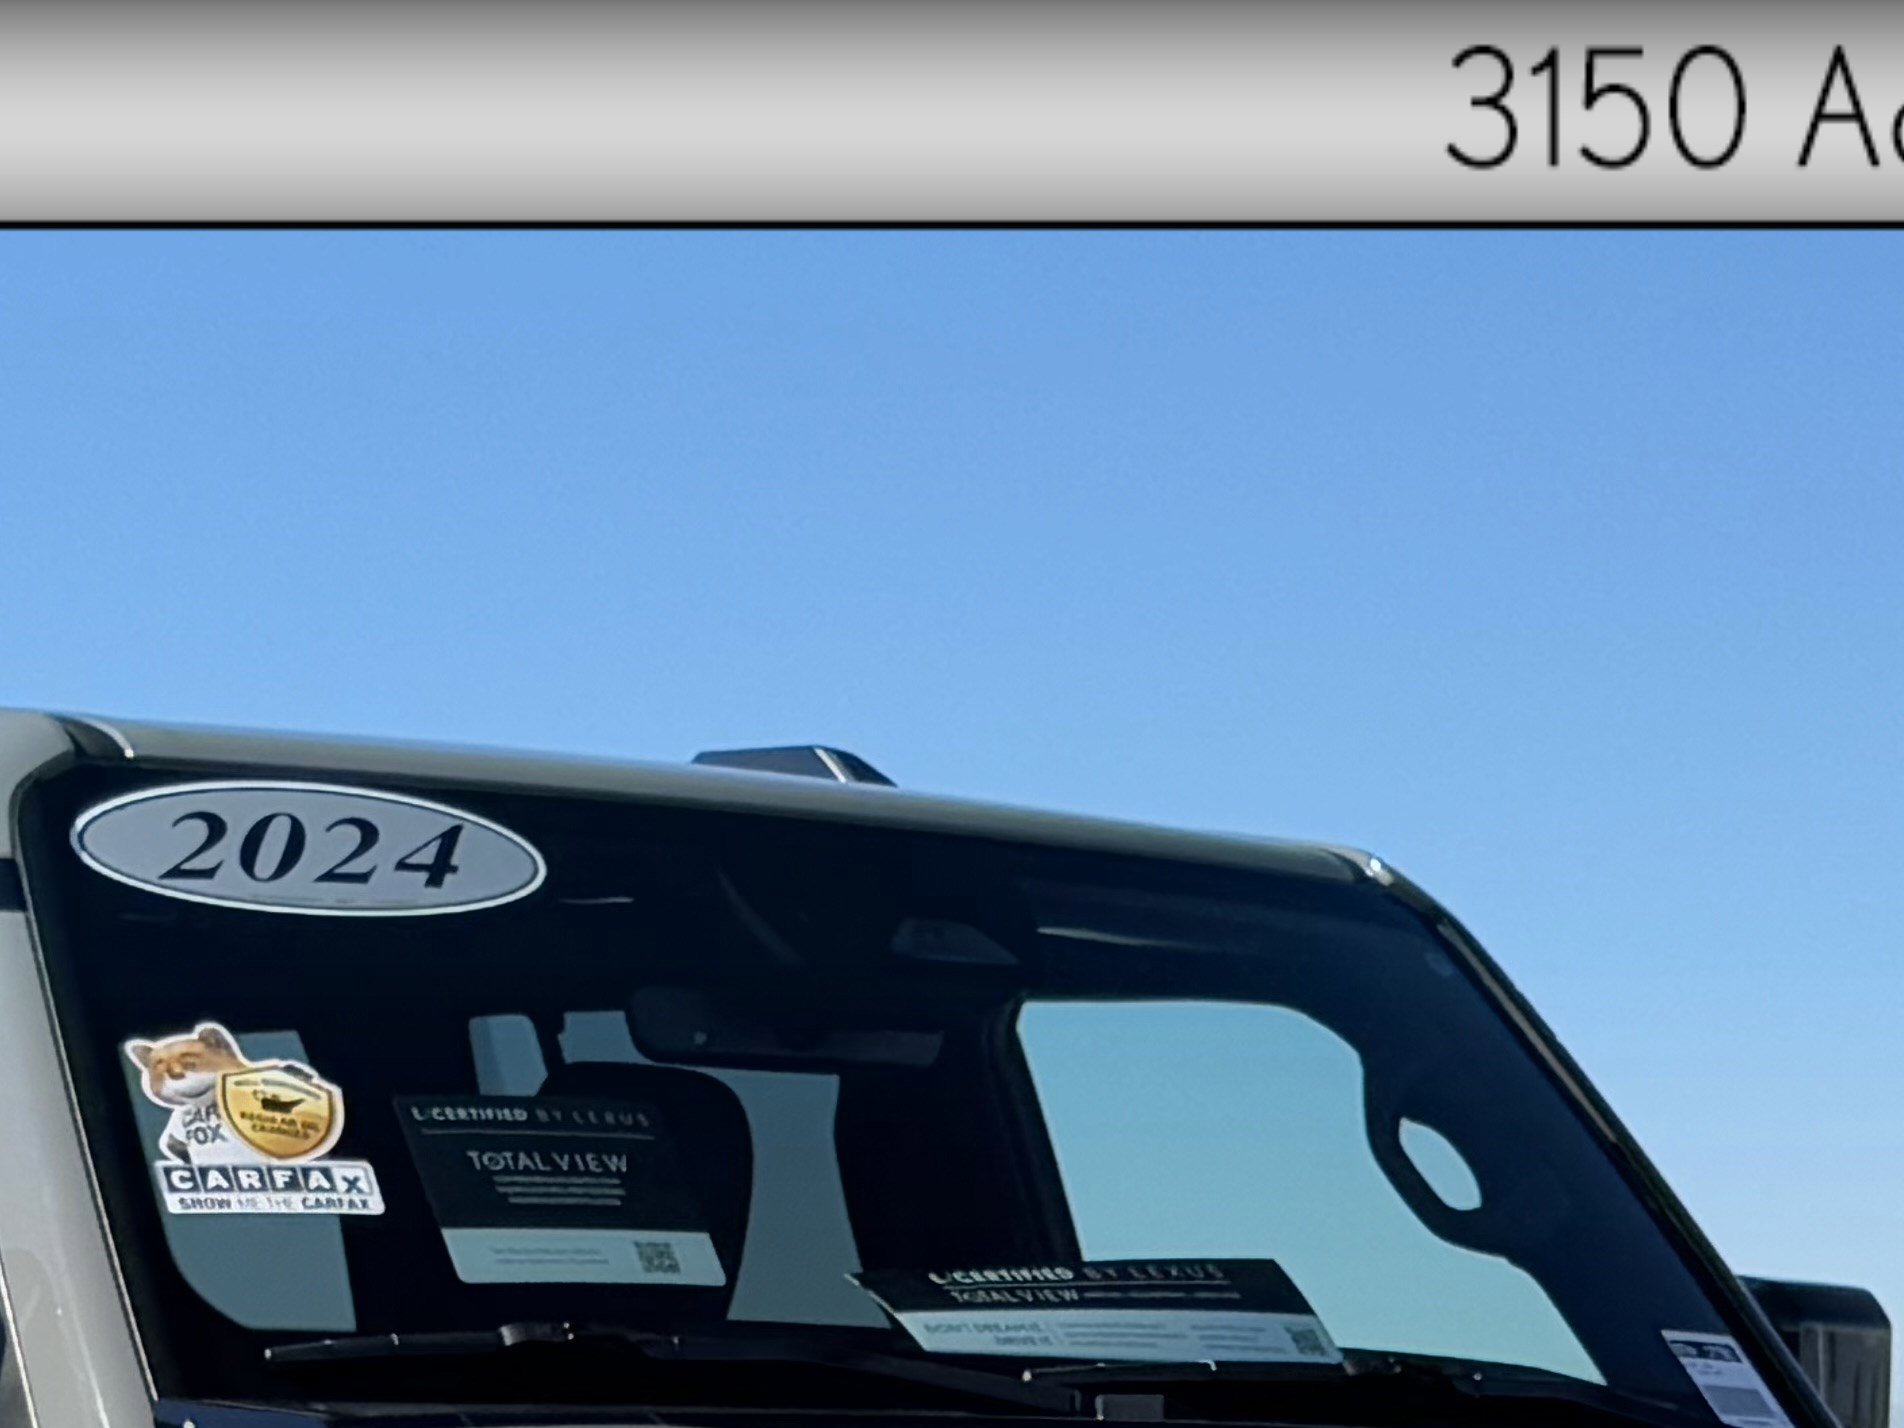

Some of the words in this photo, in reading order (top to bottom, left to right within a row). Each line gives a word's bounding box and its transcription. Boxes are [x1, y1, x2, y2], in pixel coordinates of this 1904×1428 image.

[157, 811, 466, 889] 2024
[168, 1168, 368, 1194] CARFAX
[177, 1197, 232, 1210] SHOW
[301, 1197, 370, 1210] CARFAX
